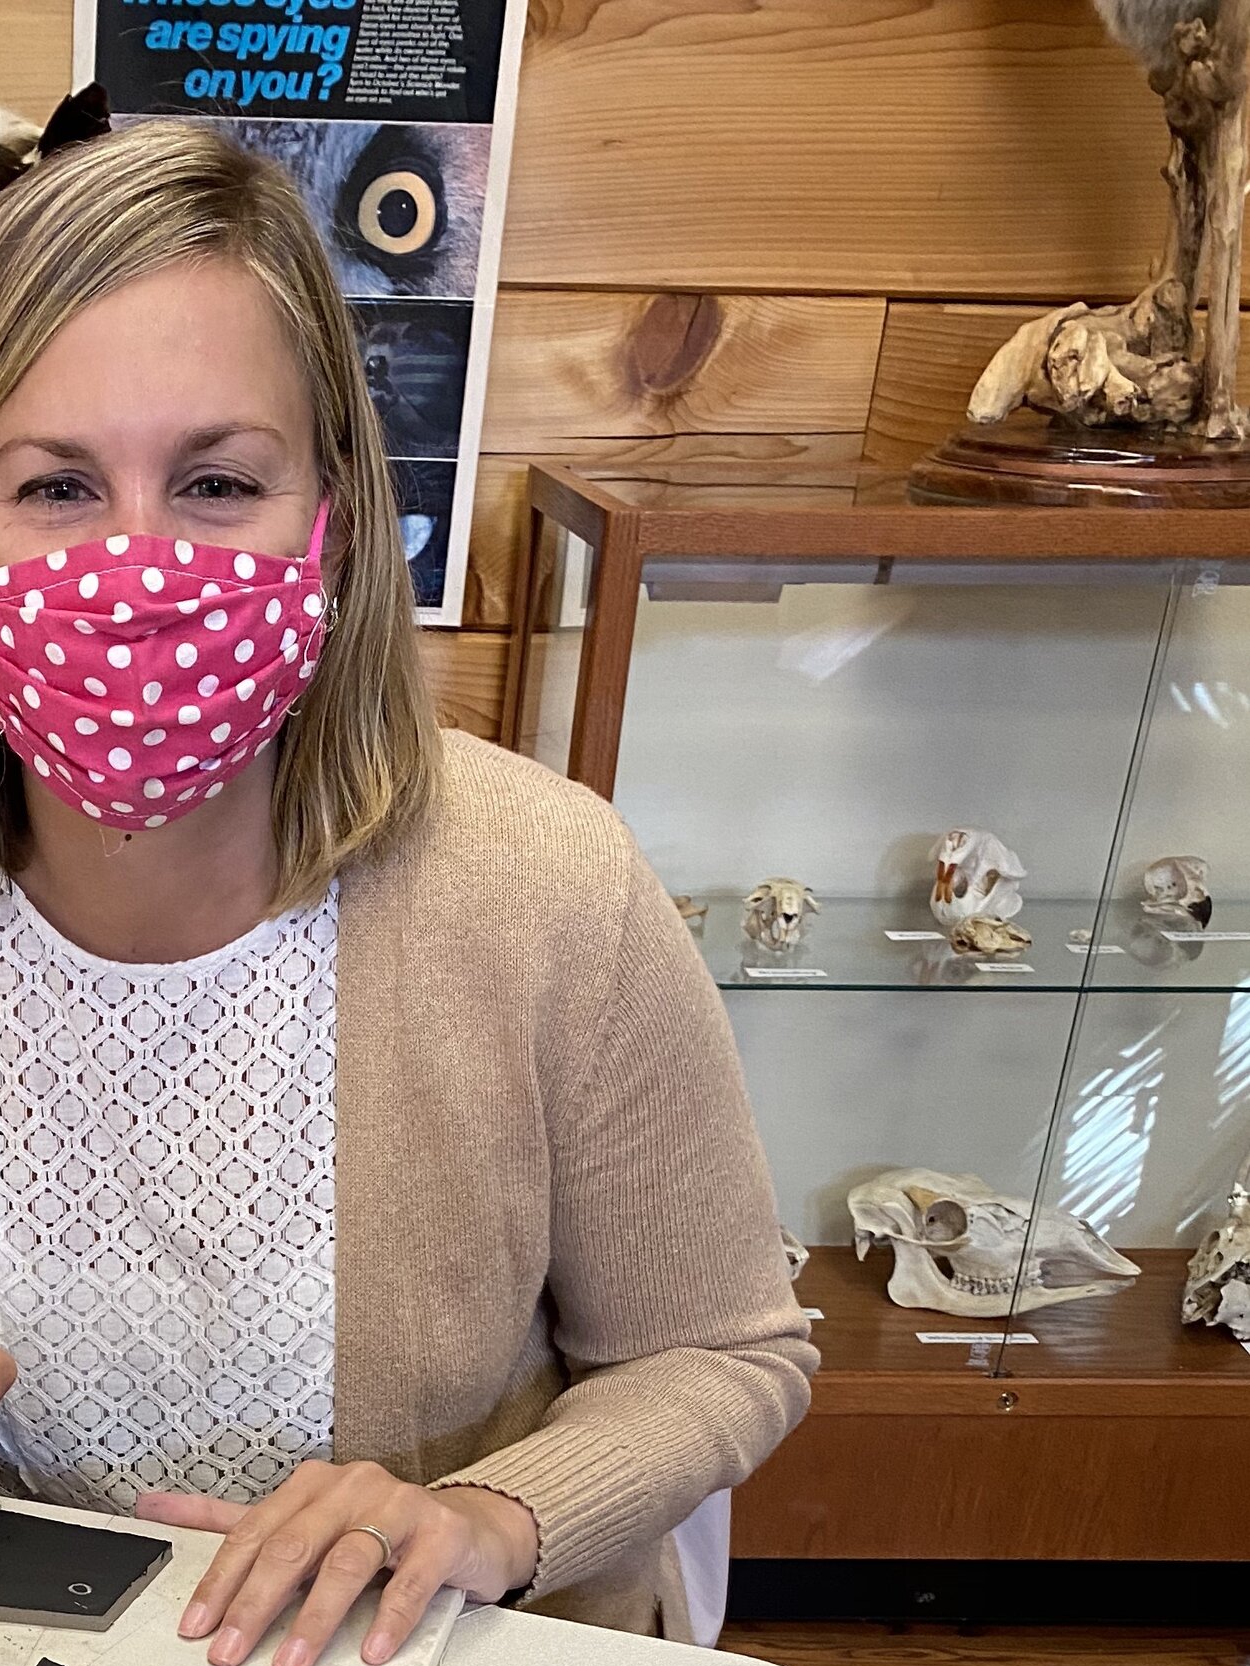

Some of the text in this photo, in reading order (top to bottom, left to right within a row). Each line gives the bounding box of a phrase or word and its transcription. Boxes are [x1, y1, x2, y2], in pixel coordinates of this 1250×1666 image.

[145, 19, 212, 50] are
[216, 13, 350, 61] spying
[184, 62, 343, 106] on you?
